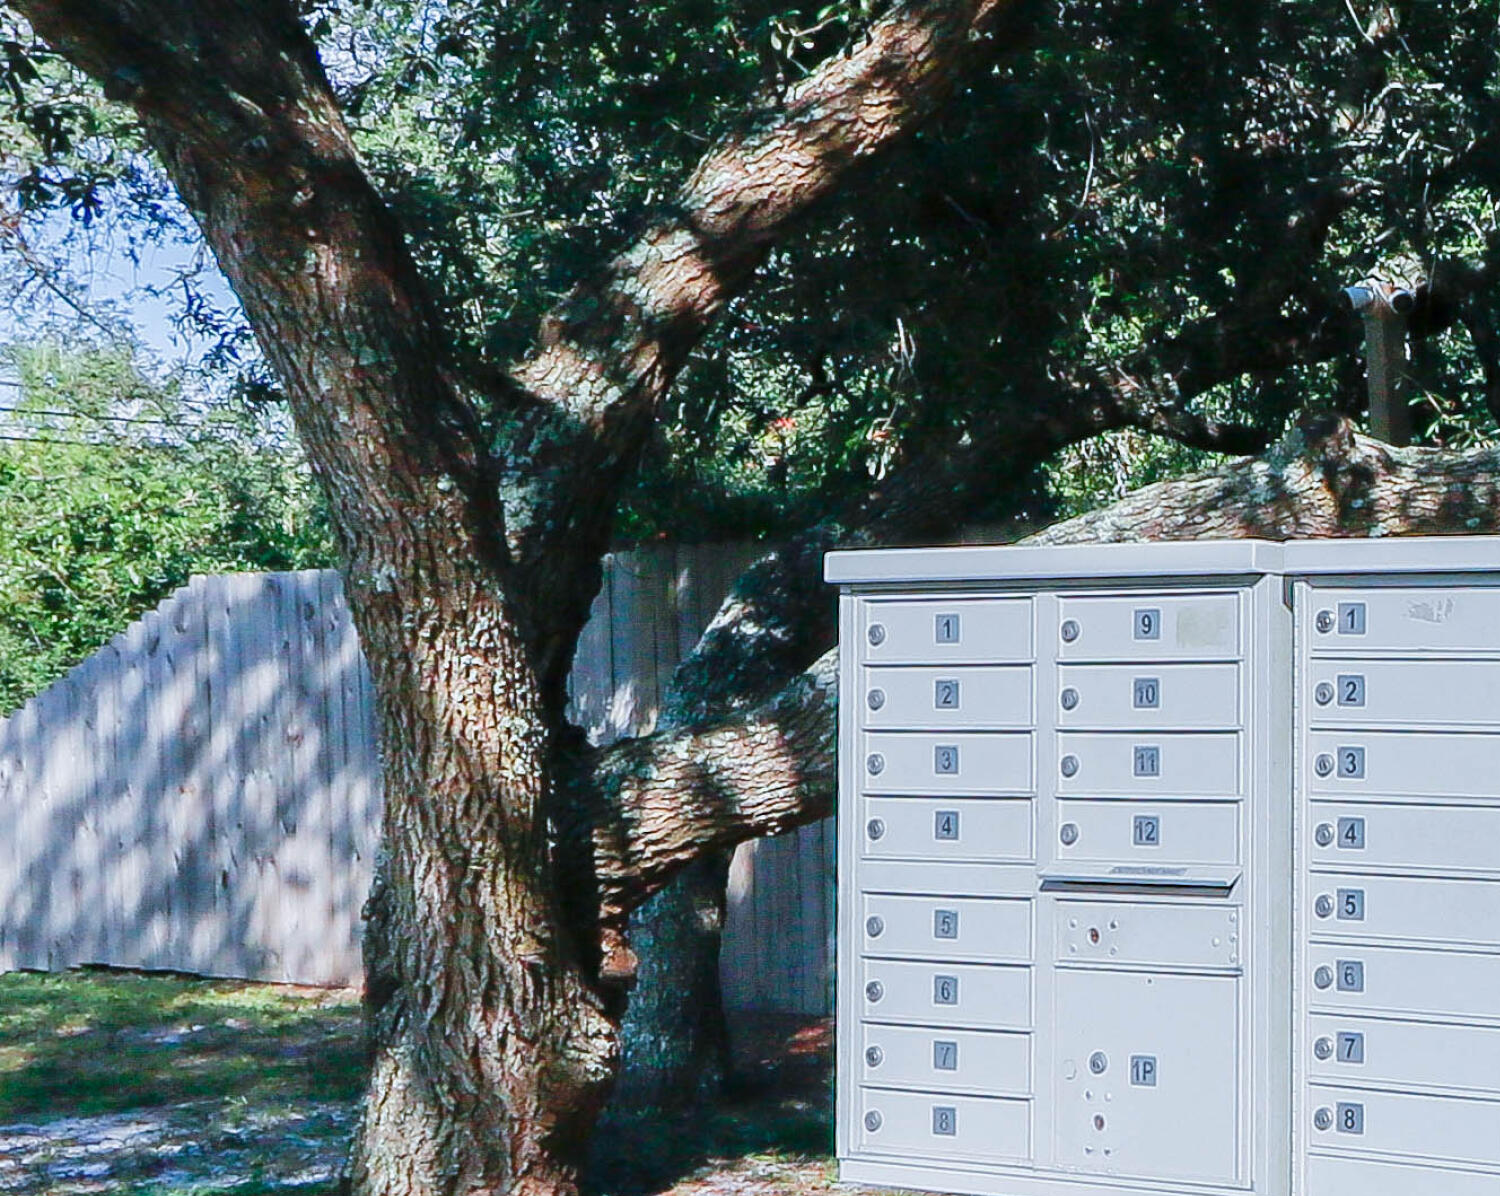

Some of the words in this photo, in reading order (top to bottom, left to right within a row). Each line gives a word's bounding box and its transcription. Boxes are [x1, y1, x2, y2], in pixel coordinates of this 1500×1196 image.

[943, 619, 951, 639] 1
[1141, 614, 1152, 635] 9
[1347, 608, 1355, 629] 1
[942, 685, 952, 704] 2
[1138, 684, 1156, 704] 10
[1345, 681, 1357, 702] 2
[942, 751, 952, 770] 3
[1138, 753, 1155, 772] 11
[1345, 752, 1357, 774] 3
[942, 816, 952, 835] 4
[1135, 821, 1156, 842] 12
[1344, 823, 1357, 844] 4
[1345, 894, 1356, 916] 5
[941, 913, 951, 934] 5
[1344, 966, 1355, 986] 6
[941, 980, 951, 1001] 6
[940, 1046, 950, 1067] 7
[1344, 1037, 1356, 1059] 7
[1134, 1061, 1154, 1081] 1P
[939, 1111, 949, 1132] 8
[1344, 1108, 1355, 1130] 8
